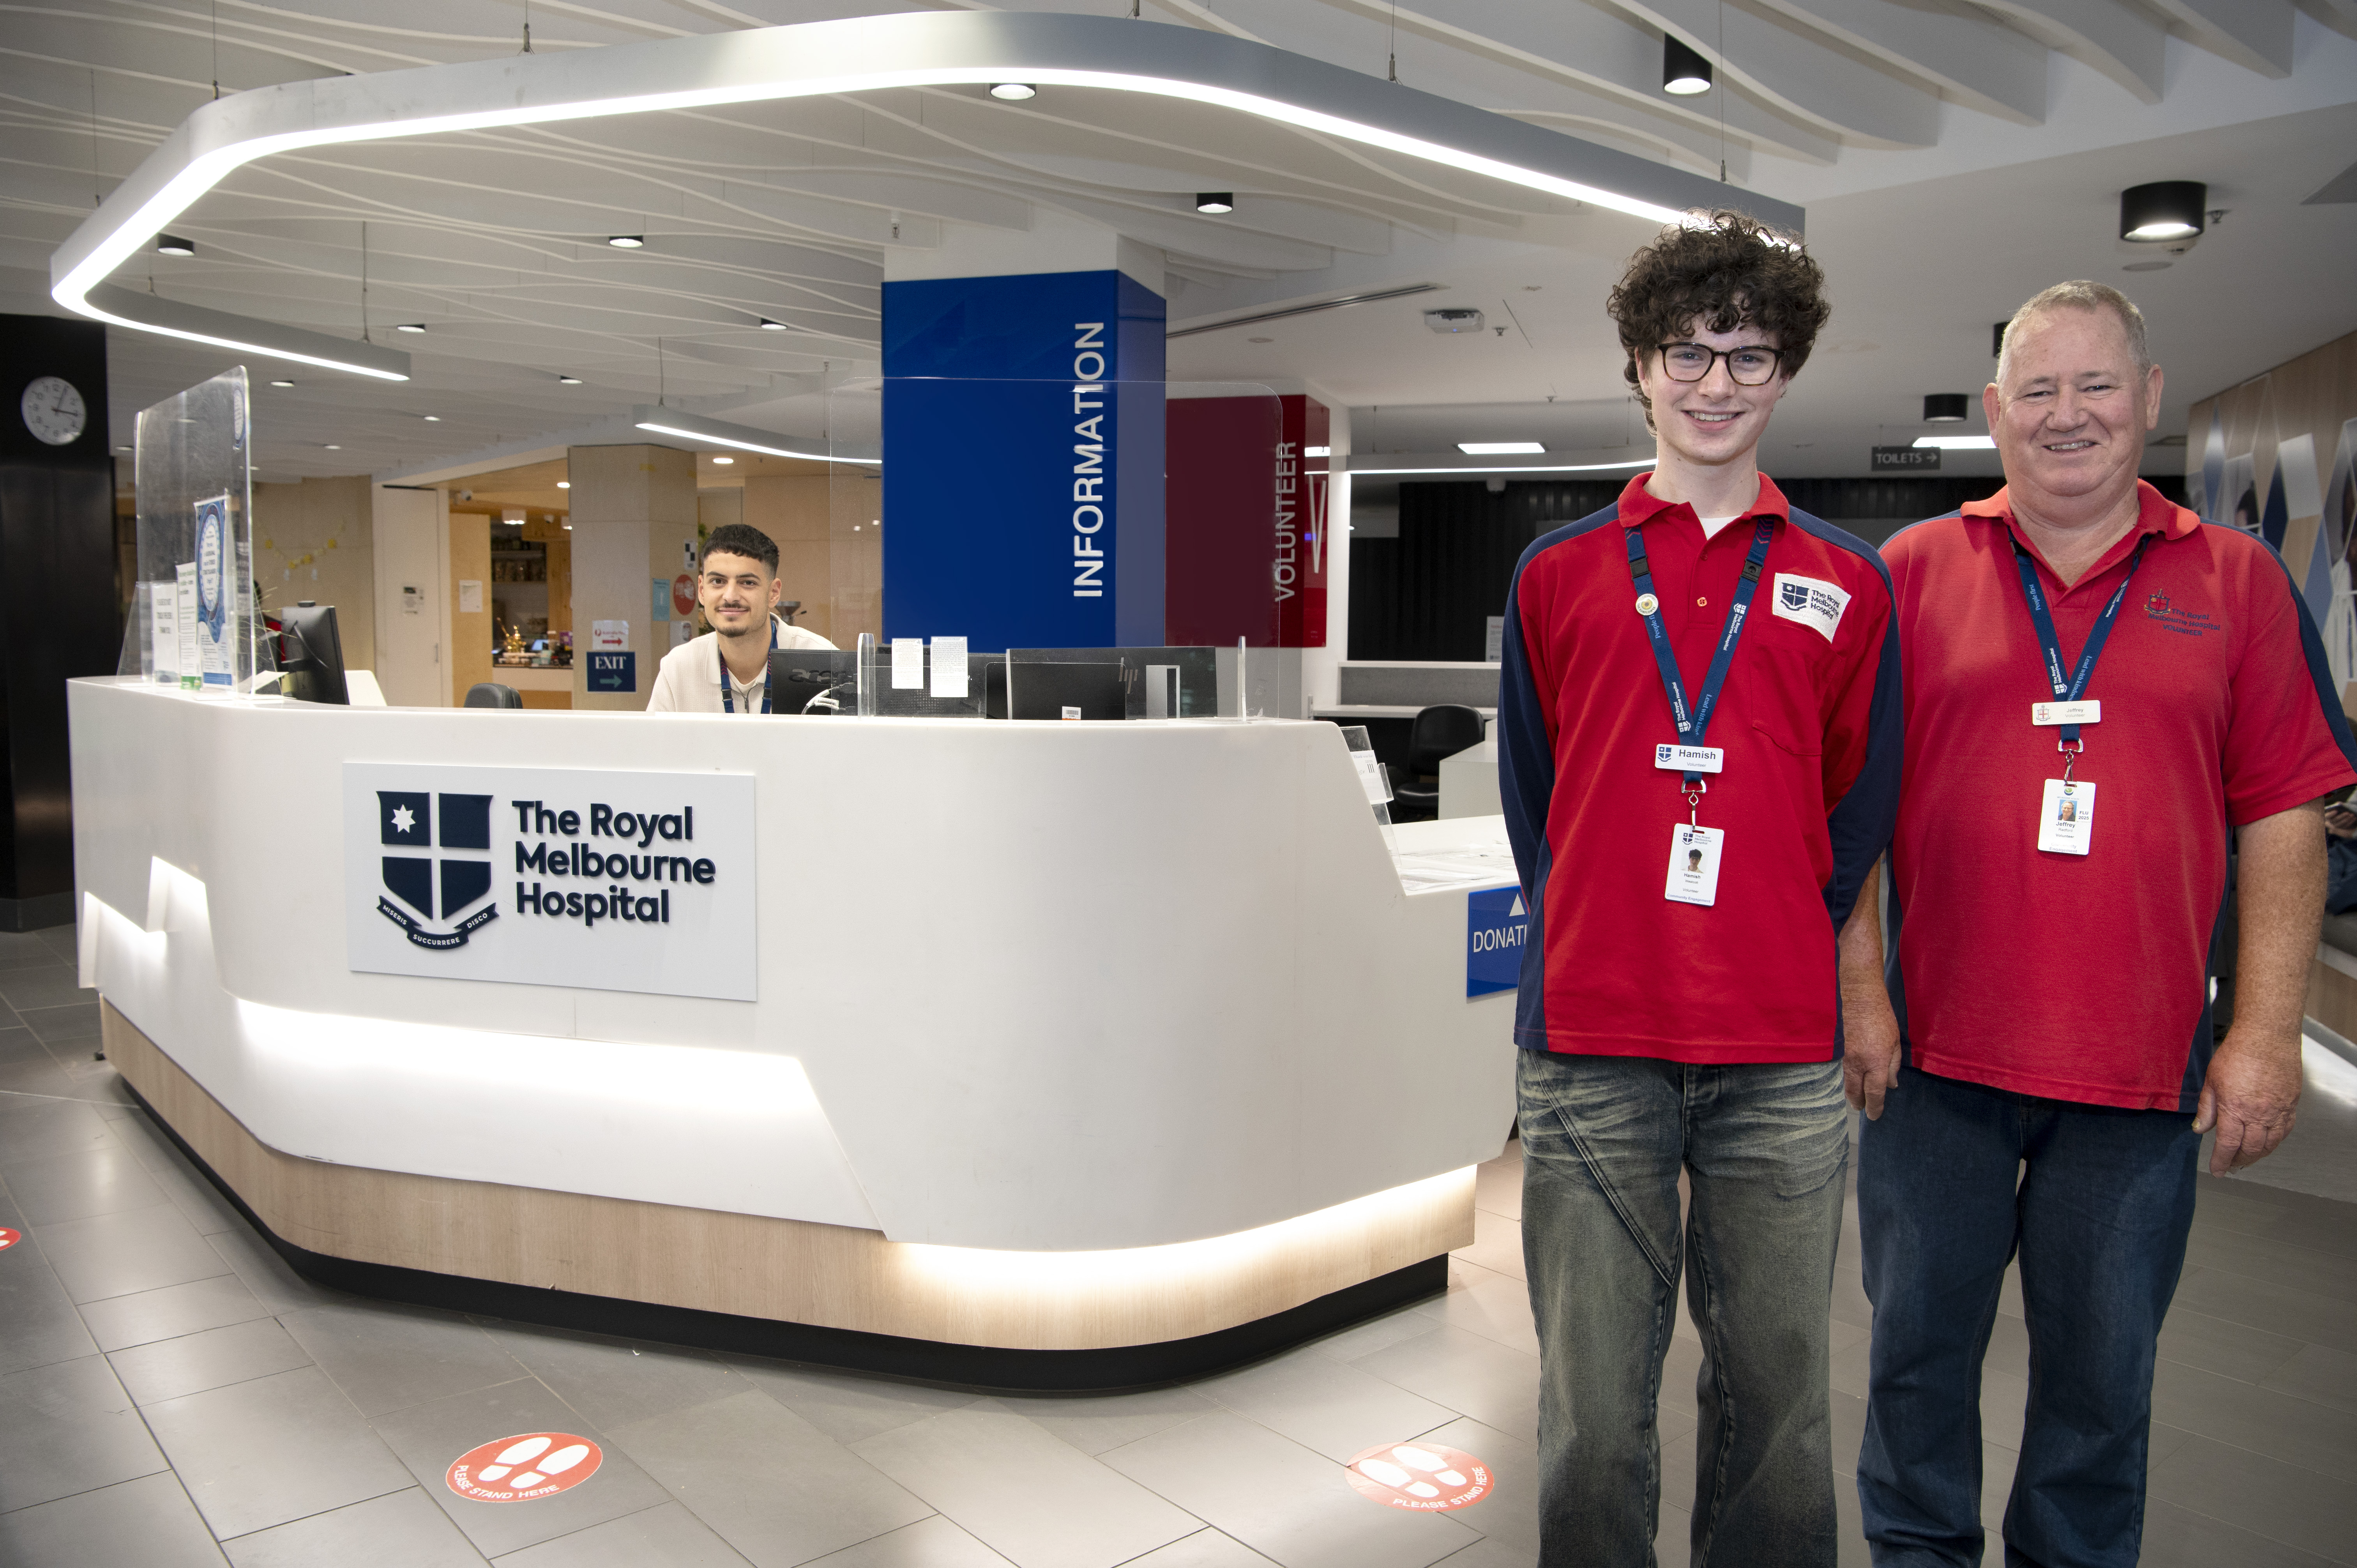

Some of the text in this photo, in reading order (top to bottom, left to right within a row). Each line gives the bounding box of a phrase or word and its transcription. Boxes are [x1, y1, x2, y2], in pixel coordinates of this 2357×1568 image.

[1074, 323, 1104, 597] INFORMATION
[1875, 452, 1922, 464] TOILETS
[1274, 441, 1296, 602] VOLUNTEER
[1811, 596, 1839, 617] Melbourne
[1812, 590, 1840, 608] The Royal
[2032, 594, 2041, 611] People
[1811, 603, 1834, 620] Hospital
[2171, 608, 2186, 616] The
[1651, 620, 1661, 639] People
[2148, 613, 2220, 630] Melbourne Hospital
[2163, 624, 2203, 636] VOLUNTEER
[1723, 614, 1739, 651] Melbourne Hospital
[595, 656, 627, 669] EXIT
[2082, 656, 2092, 669] Lead
[2077, 669, 2086, 682] with
[1672, 682, 1686, 720] Melbourne Hospital
[1703, 694, 1712, 708] Lead
[1679, 749, 1716, 759] Hamish
[512, 800, 693, 848] The Royal
[516, 841, 716, 884] Melbourne
[517, 882, 670, 927] Hospital
[382, 904, 408, 926] MISERIS
[466, 912, 489, 929] DISCO
[413, 934, 461, 946] SUCCURRERE
[1474, 925, 1527, 953] DONATI
[454, 1464, 560, 1499] PLEASE STAND HERE
[1392, 1466, 1488, 1508] PLEASE STAND HERE
